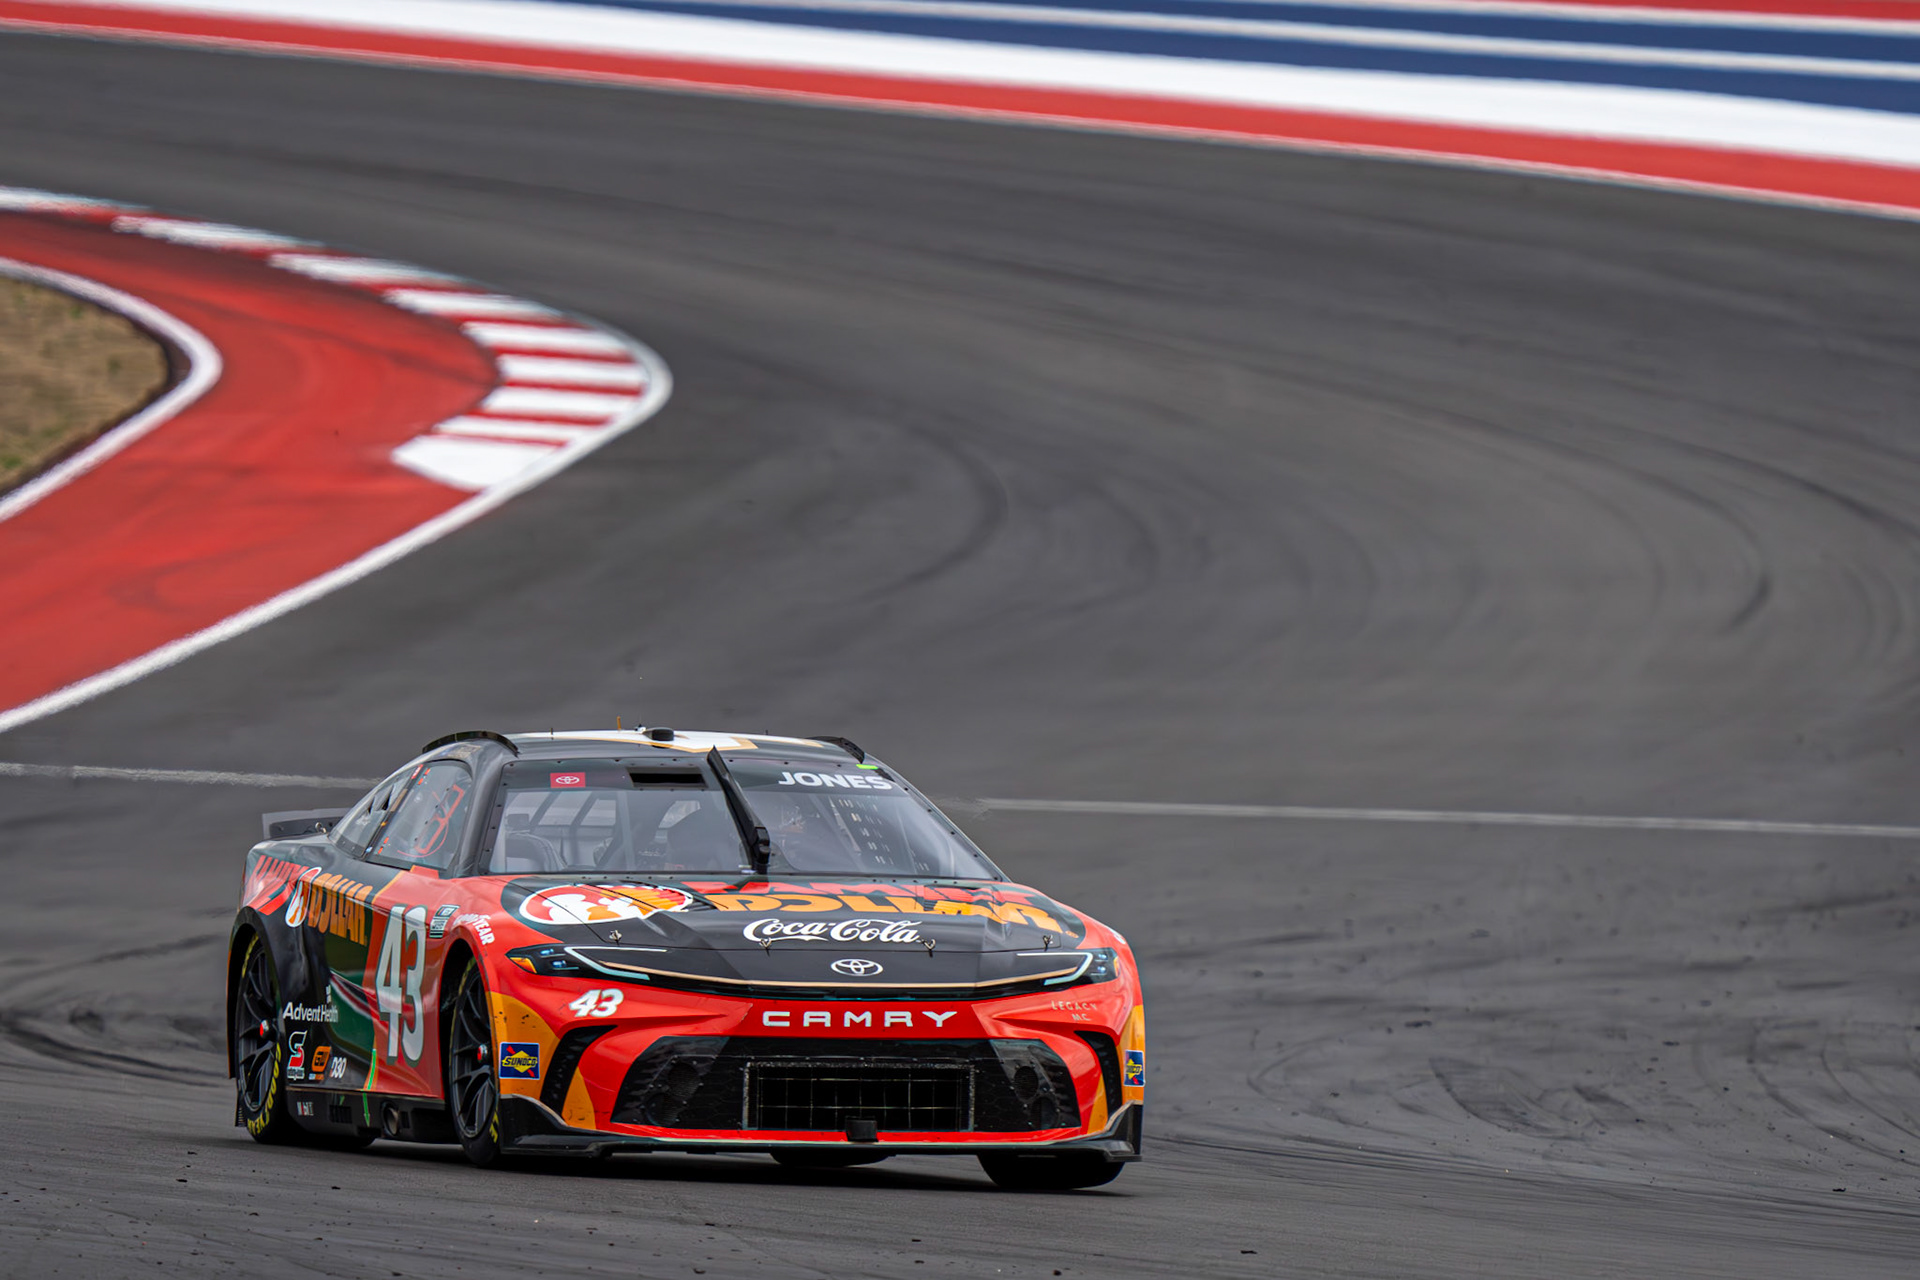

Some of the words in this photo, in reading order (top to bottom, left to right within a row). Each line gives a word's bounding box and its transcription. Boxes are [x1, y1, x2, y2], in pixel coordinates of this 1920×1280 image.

[778, 772, 892, 790] JONES
[704, 894, 1063, 934] DOLLAR
[743, 918, 923, 945] Coca-Cola
[376, 904, 427, 1067] 43
[568, 988, 624, 1018] 43
[1051, 1001, 1098, 1012] LEGACY
[762, 1010, 958, 1028] CAMRY
[1071, 1013, 1092, 1022] MC
[503, 1056, 538, 1067] SUNOCO
